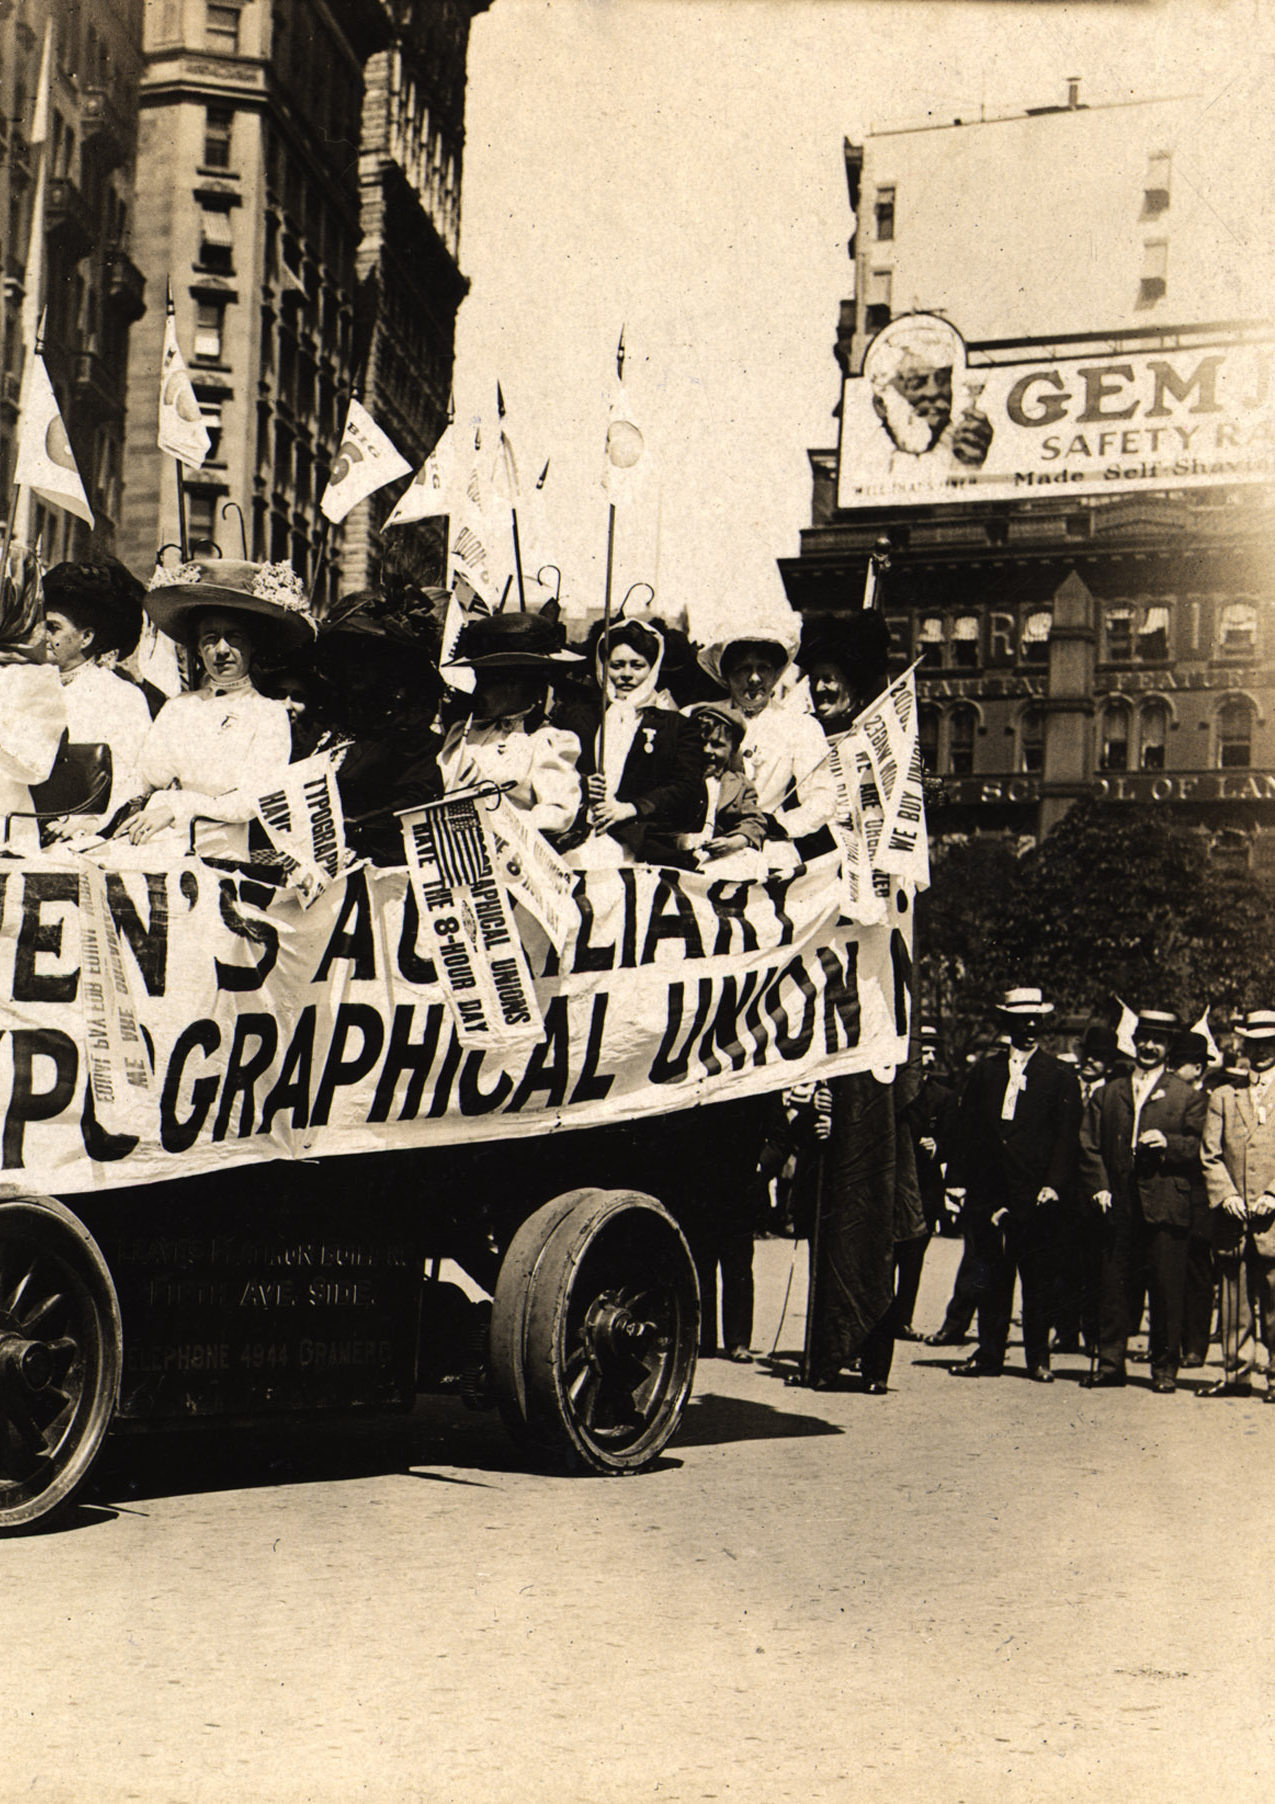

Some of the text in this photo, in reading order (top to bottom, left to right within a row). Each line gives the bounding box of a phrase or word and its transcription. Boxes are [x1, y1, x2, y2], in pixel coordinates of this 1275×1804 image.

[1007, 355, 1225, 428] GEM
[347, 422, 381, 459] BIG
[1041, 425, 1200, 461] SAFETY
[1015, 469, 1085, 487] Made
[860, 782, 882, 812] ARE
[897, 789, 923, 823] BUY
[1152, 777, 1199, 801] OF
[412, 821, 437, 868] HAVE
[889, 827, 919, 853] WE
[422, 879, 455, 912] THE
[312, 865, 807, 984] AULIARY
[434, 915, 476, 992] 8-HOUR
[490, 957, 532, 1026] UNIONS
[457, 998, 490, 1034] DAY
[648, 940, 862, 1086] UNION
[308, 1275, 376, 1306] SIDE.
[126, 1337, 392, 1371] ELEPHONE 4944 GRAMERC
